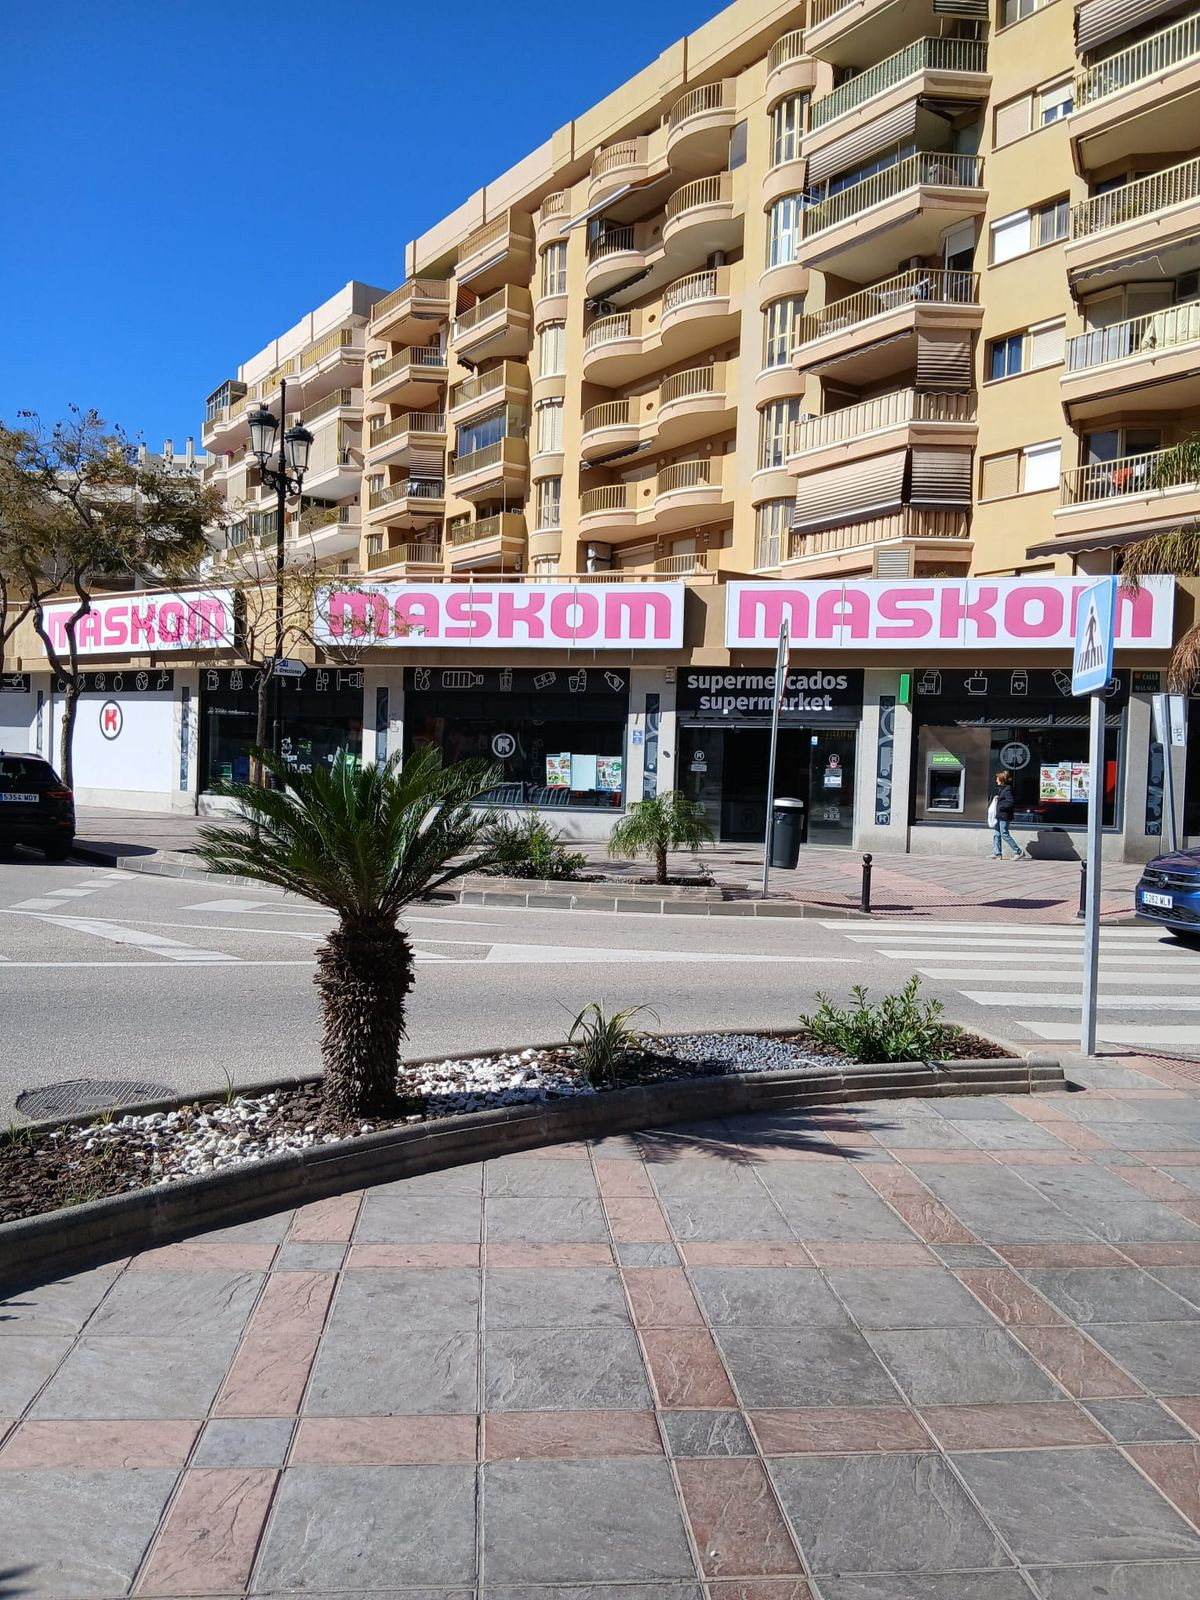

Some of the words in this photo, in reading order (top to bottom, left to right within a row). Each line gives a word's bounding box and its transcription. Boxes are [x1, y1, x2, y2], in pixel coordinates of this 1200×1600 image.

[49, 600, 225, 648] MASKOM
[329, 592, 671, 639] MASKOM
[687, 671, 848, 693] supermecados
